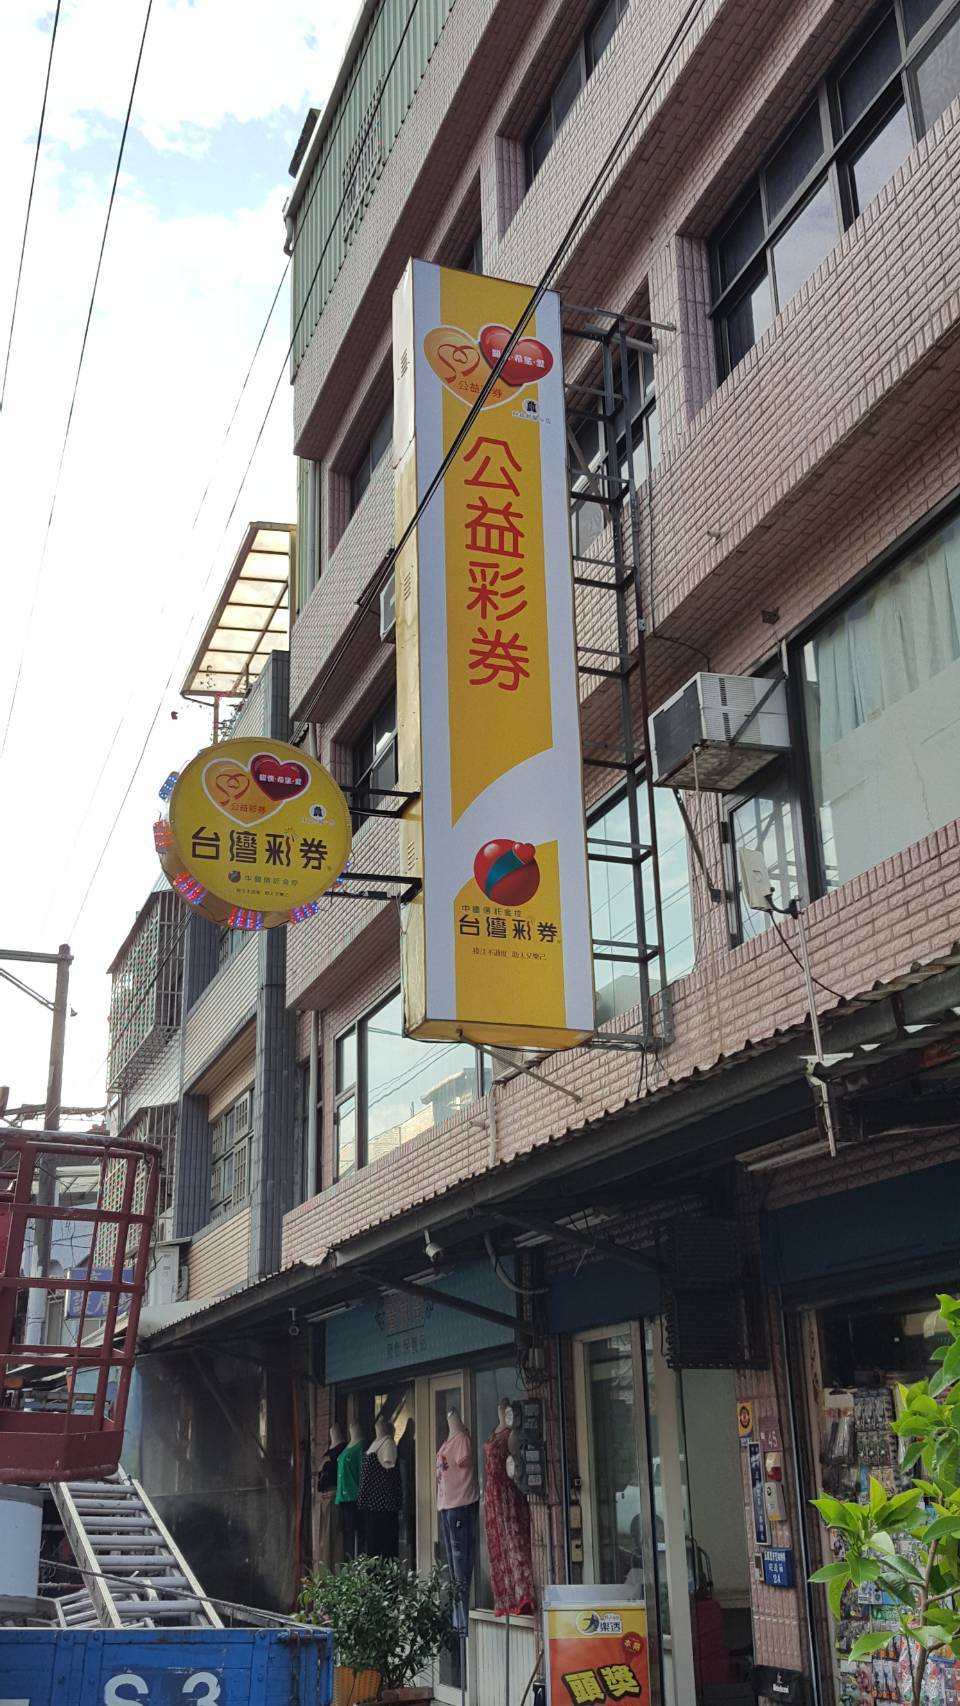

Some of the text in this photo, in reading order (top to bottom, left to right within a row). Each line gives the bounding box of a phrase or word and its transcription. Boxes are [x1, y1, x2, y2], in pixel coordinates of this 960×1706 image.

[463, 435, 530, 691] 公益彩券
[191, 826, 328, 871] 台灣彩券
[458, 914, 558, 943] 台灣彩券
[563, 1664, 641, 1705] 頭獎
